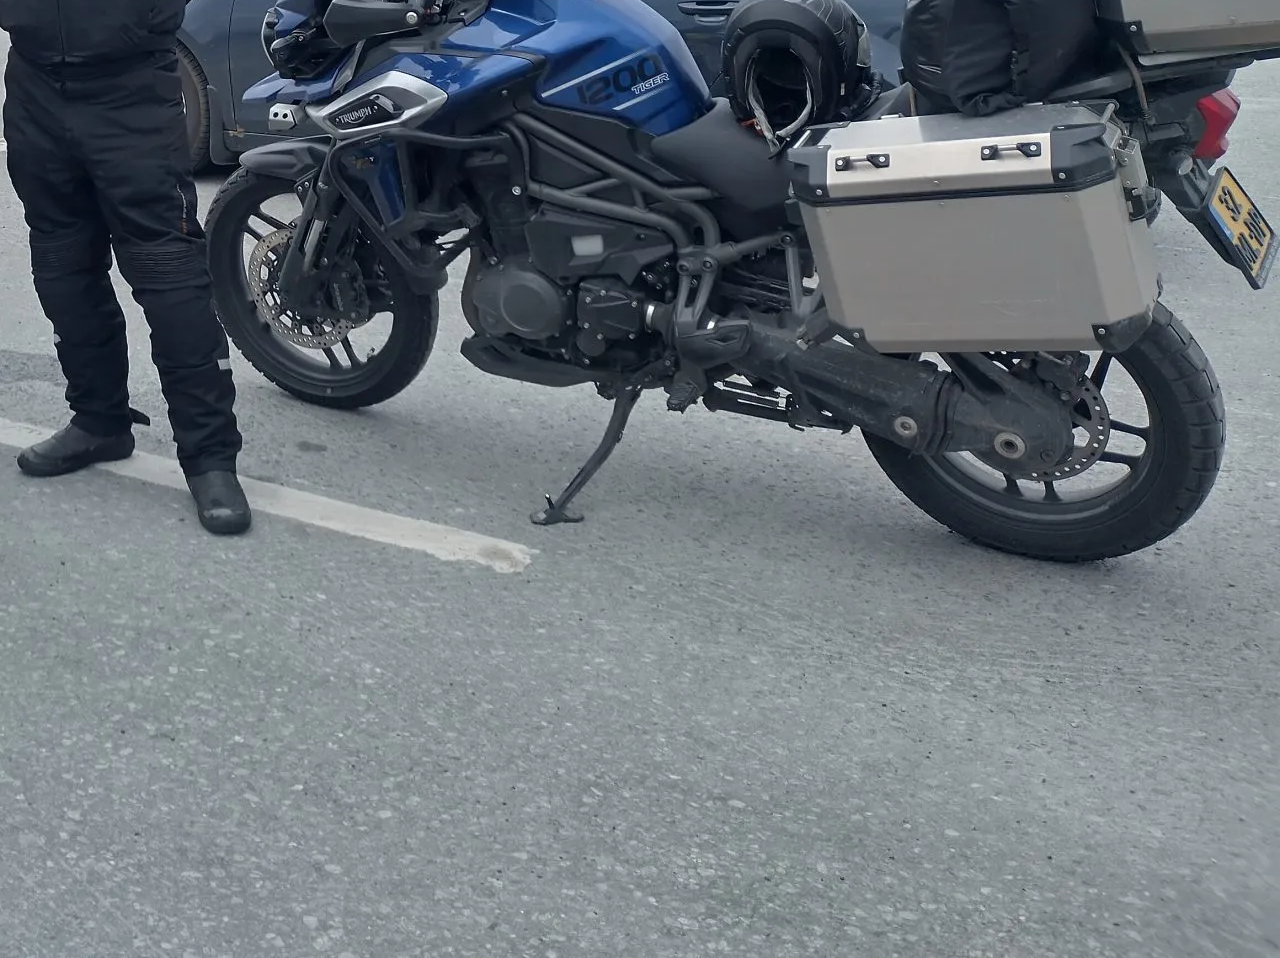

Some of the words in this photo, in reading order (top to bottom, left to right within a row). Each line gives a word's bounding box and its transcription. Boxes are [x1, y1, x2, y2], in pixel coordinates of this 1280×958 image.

[575, 52, 663, 105] 1200
[631, 71, 670, 95] TIGER
[337, 106, 372, 124] TRIUMPH
[1218, 185, 1242, 222] 32
